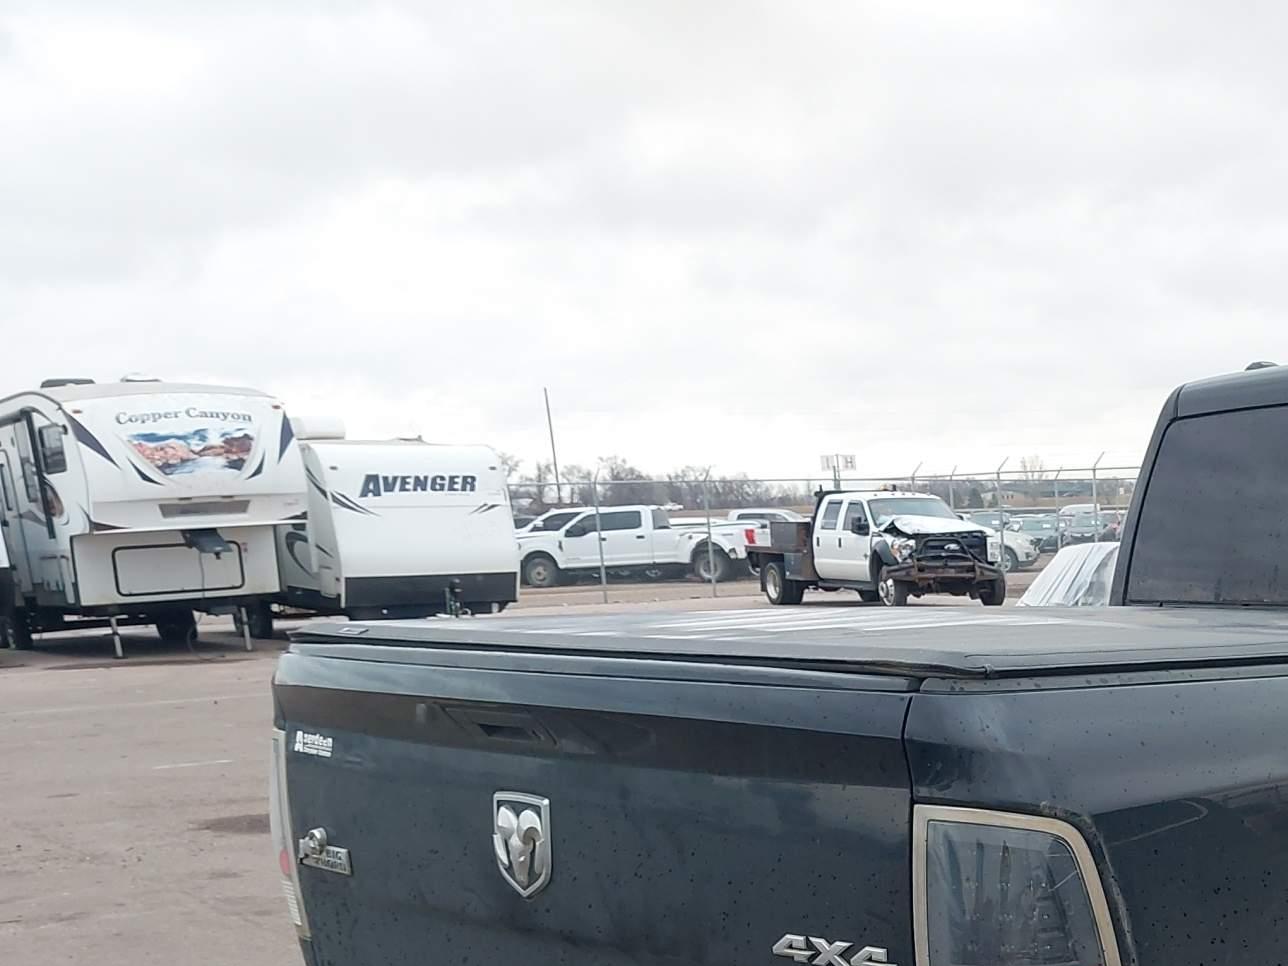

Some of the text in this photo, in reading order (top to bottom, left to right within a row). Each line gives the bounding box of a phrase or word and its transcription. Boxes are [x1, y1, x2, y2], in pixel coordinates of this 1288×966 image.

[115, 407, 252, 425] Copper Canyon
[359, 474, 477, 497] AVENGER
